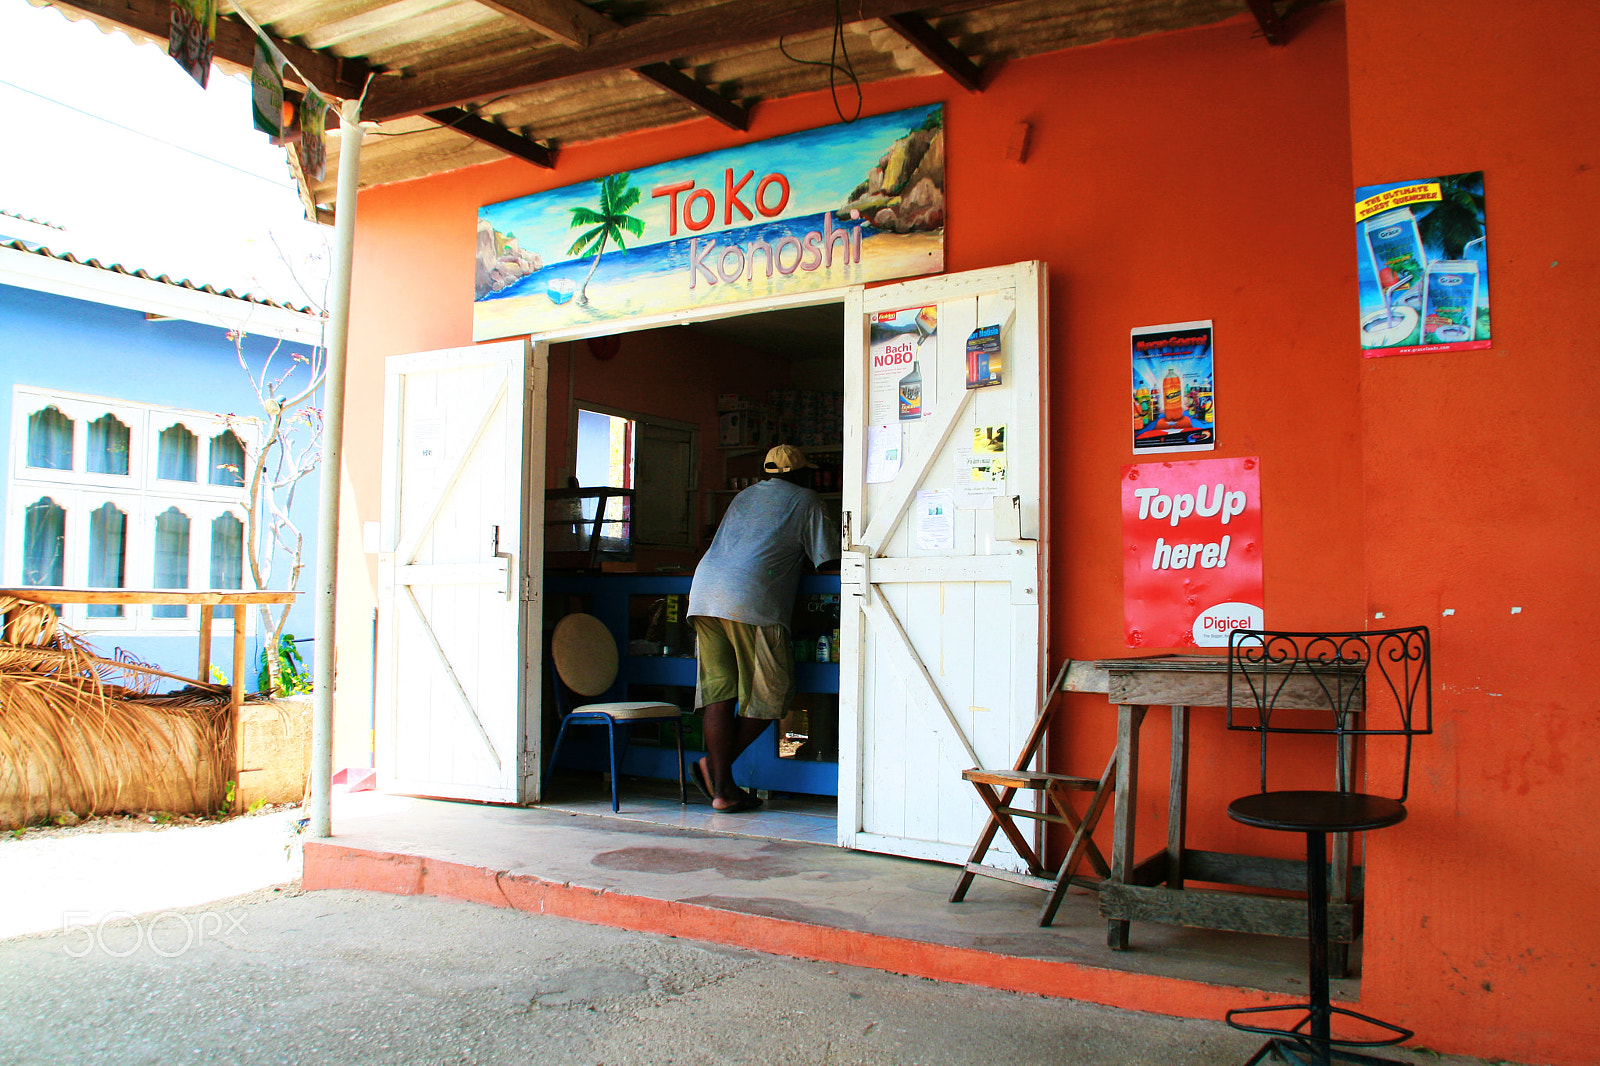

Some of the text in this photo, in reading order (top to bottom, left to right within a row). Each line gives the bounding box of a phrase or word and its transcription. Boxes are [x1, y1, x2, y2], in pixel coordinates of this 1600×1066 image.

[1359, 192, 1438, 217] THIRST QUENCHER
[1364, 185, 1429, 207] THE ULTIMATE
[689, 209, 863, 289] Konoshi
[874, 351, 913, 368] NOBO
[885, 342, 912, 354] Bachi
[1134, 483, 1247, 527] TopUp
[1152, 535, 1231, 570] here!
[1203, 616, 1251, 632] Digicel
